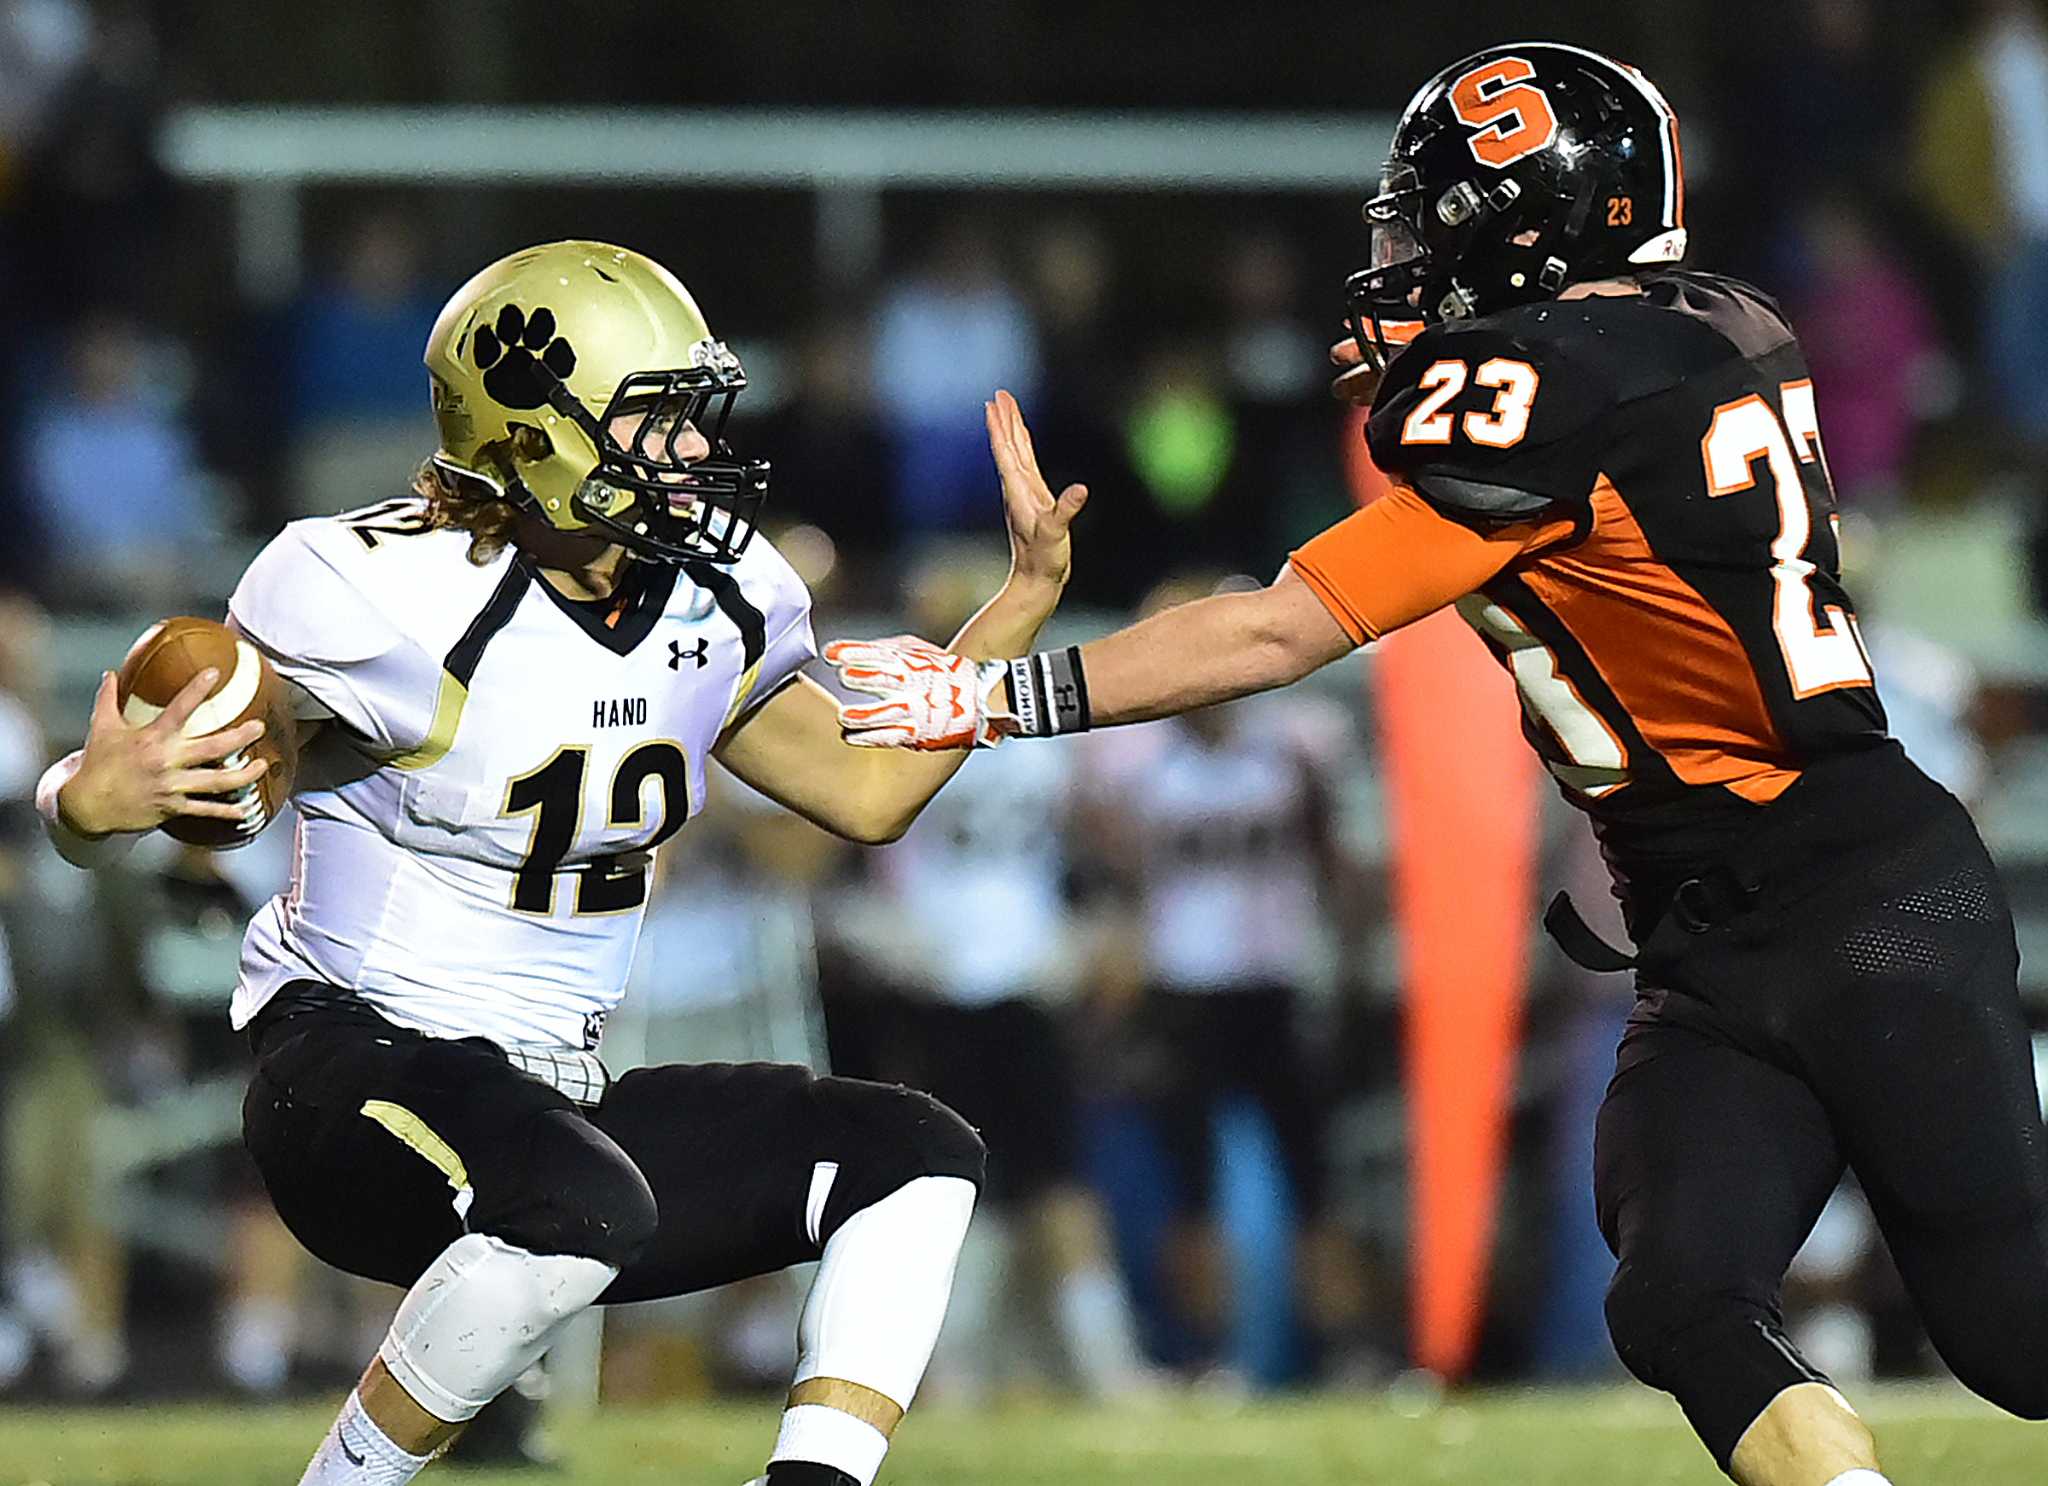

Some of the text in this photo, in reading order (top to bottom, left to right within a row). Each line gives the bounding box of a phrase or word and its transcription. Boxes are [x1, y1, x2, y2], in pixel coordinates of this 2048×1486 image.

[1450, 56, 1558, 169] S
[1607, 197, 1632, 226] 23
[1401, 358, 1540, 449] 23
[592, 698, 647, 728] HAND
[496, 738, 691, 918] 12
